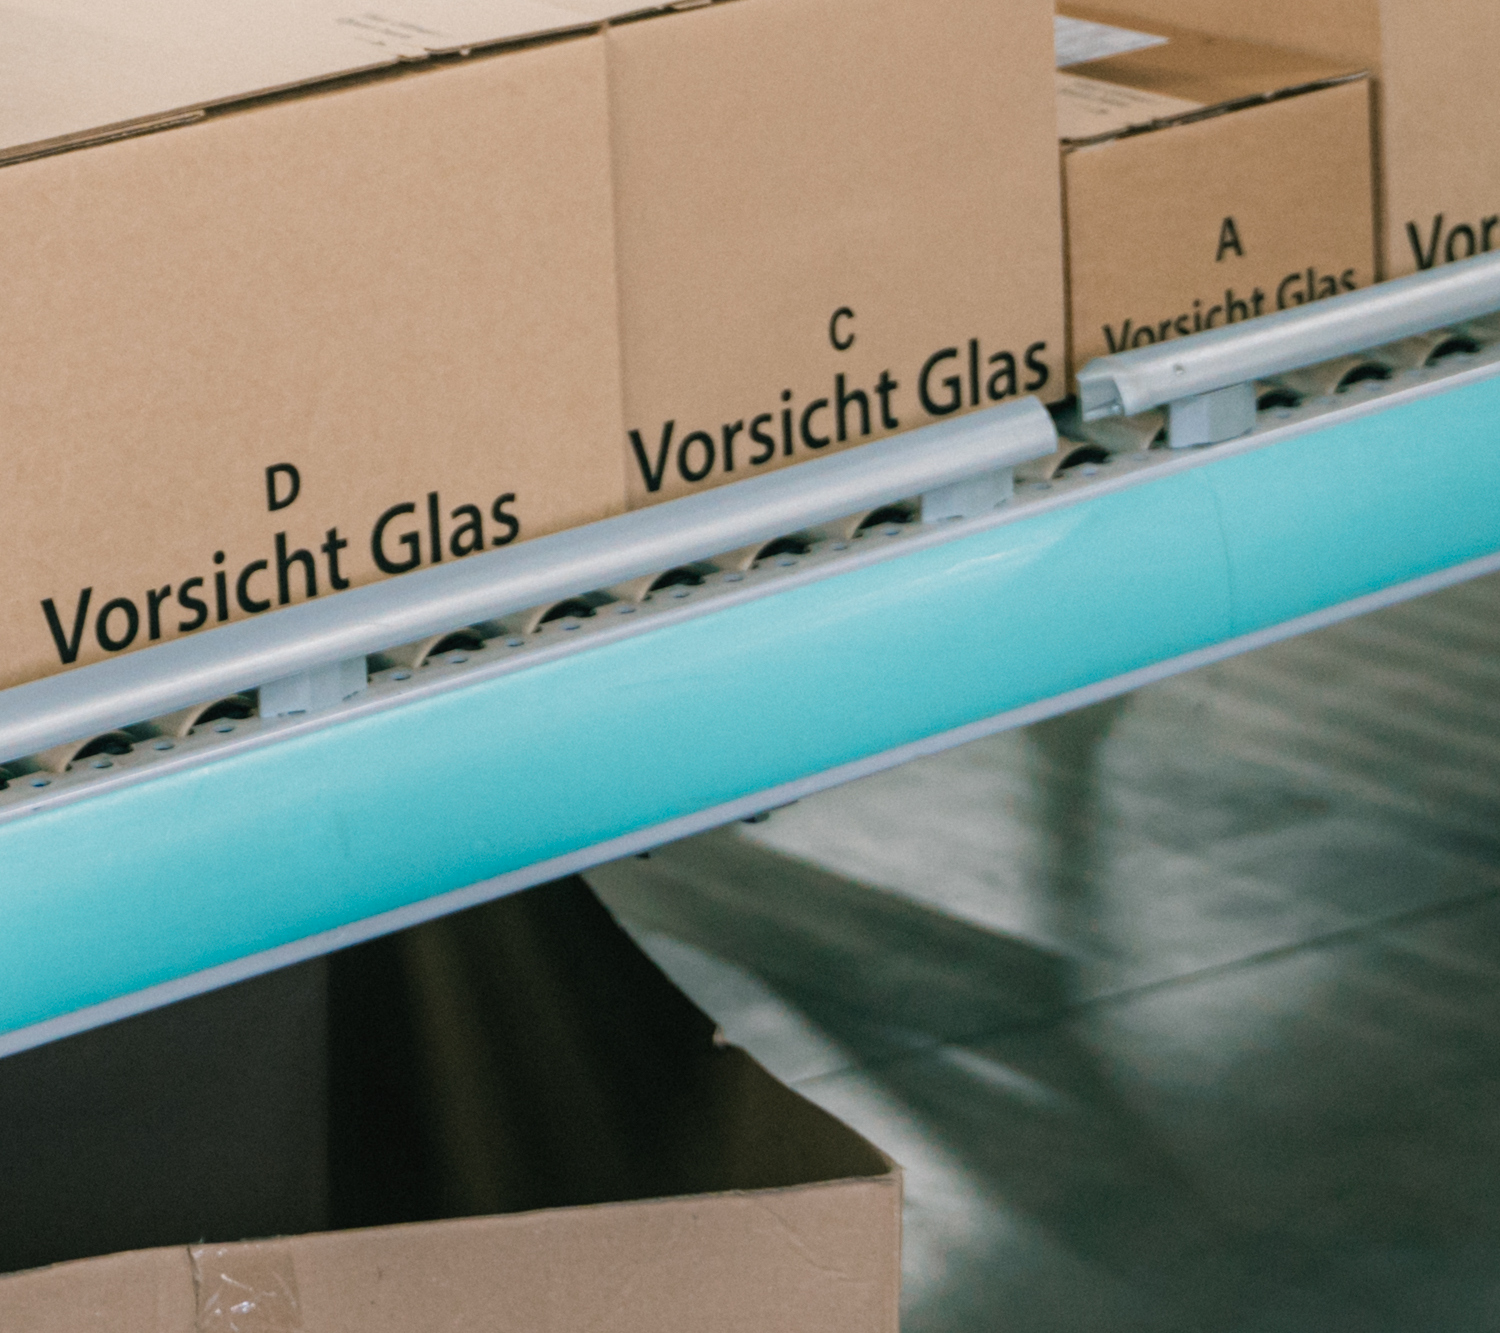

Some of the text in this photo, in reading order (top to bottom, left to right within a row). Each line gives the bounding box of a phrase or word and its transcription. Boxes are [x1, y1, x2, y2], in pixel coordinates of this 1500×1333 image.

[1216, 216, 1243, 262] A
[828, 307, 855, 351] C
[1102, 267, 1357, 354] Vorsicht Glas
[627, 338, 1049, 493] Vorsicht Glas
[265, 462, 300, 511] D
[40, 491, 521, 665] Vorsicht Glas
